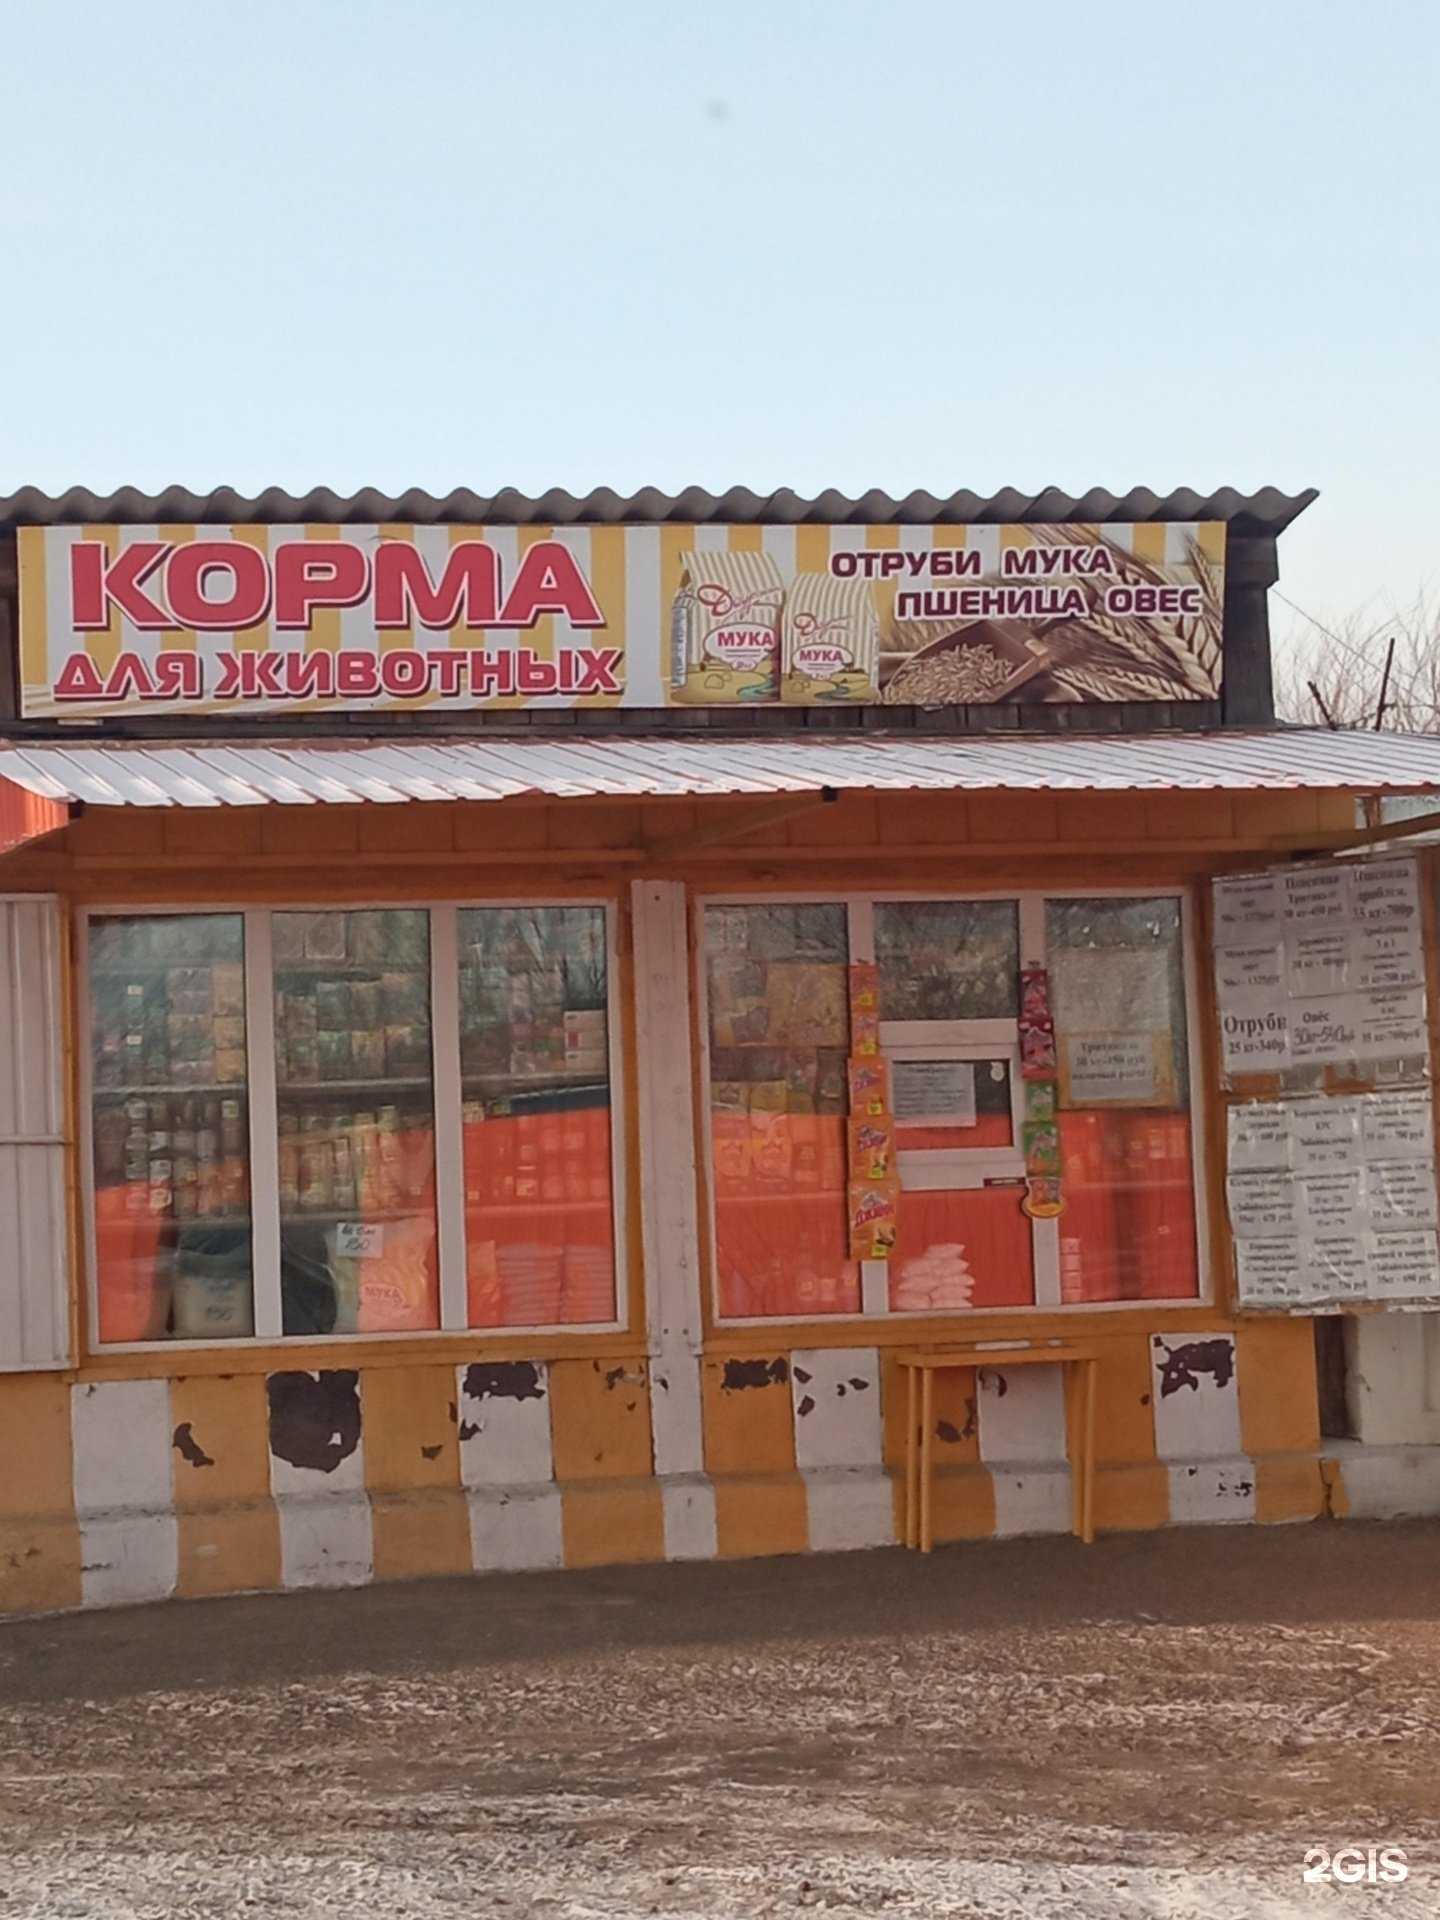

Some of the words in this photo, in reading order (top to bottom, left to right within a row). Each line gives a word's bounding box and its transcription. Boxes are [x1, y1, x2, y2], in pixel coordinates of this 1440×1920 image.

[830, 549, 982, 579] ОТРУБИ
[1004, 546, 1113, 576] МУКА
[70, 540, 606, 631] КОРМА
[897, 587, 1087, 618] ПШЕНИЦА
[1108, 586, 1200, 614] ОВЕС
[717, 631, 774, 647] МУКА
[799, 650, 844, 662] МУКА
[53, 650, 202, 699] ДЛЯ
[216, 647, 625, 698] ЖИВОТНЫХ
